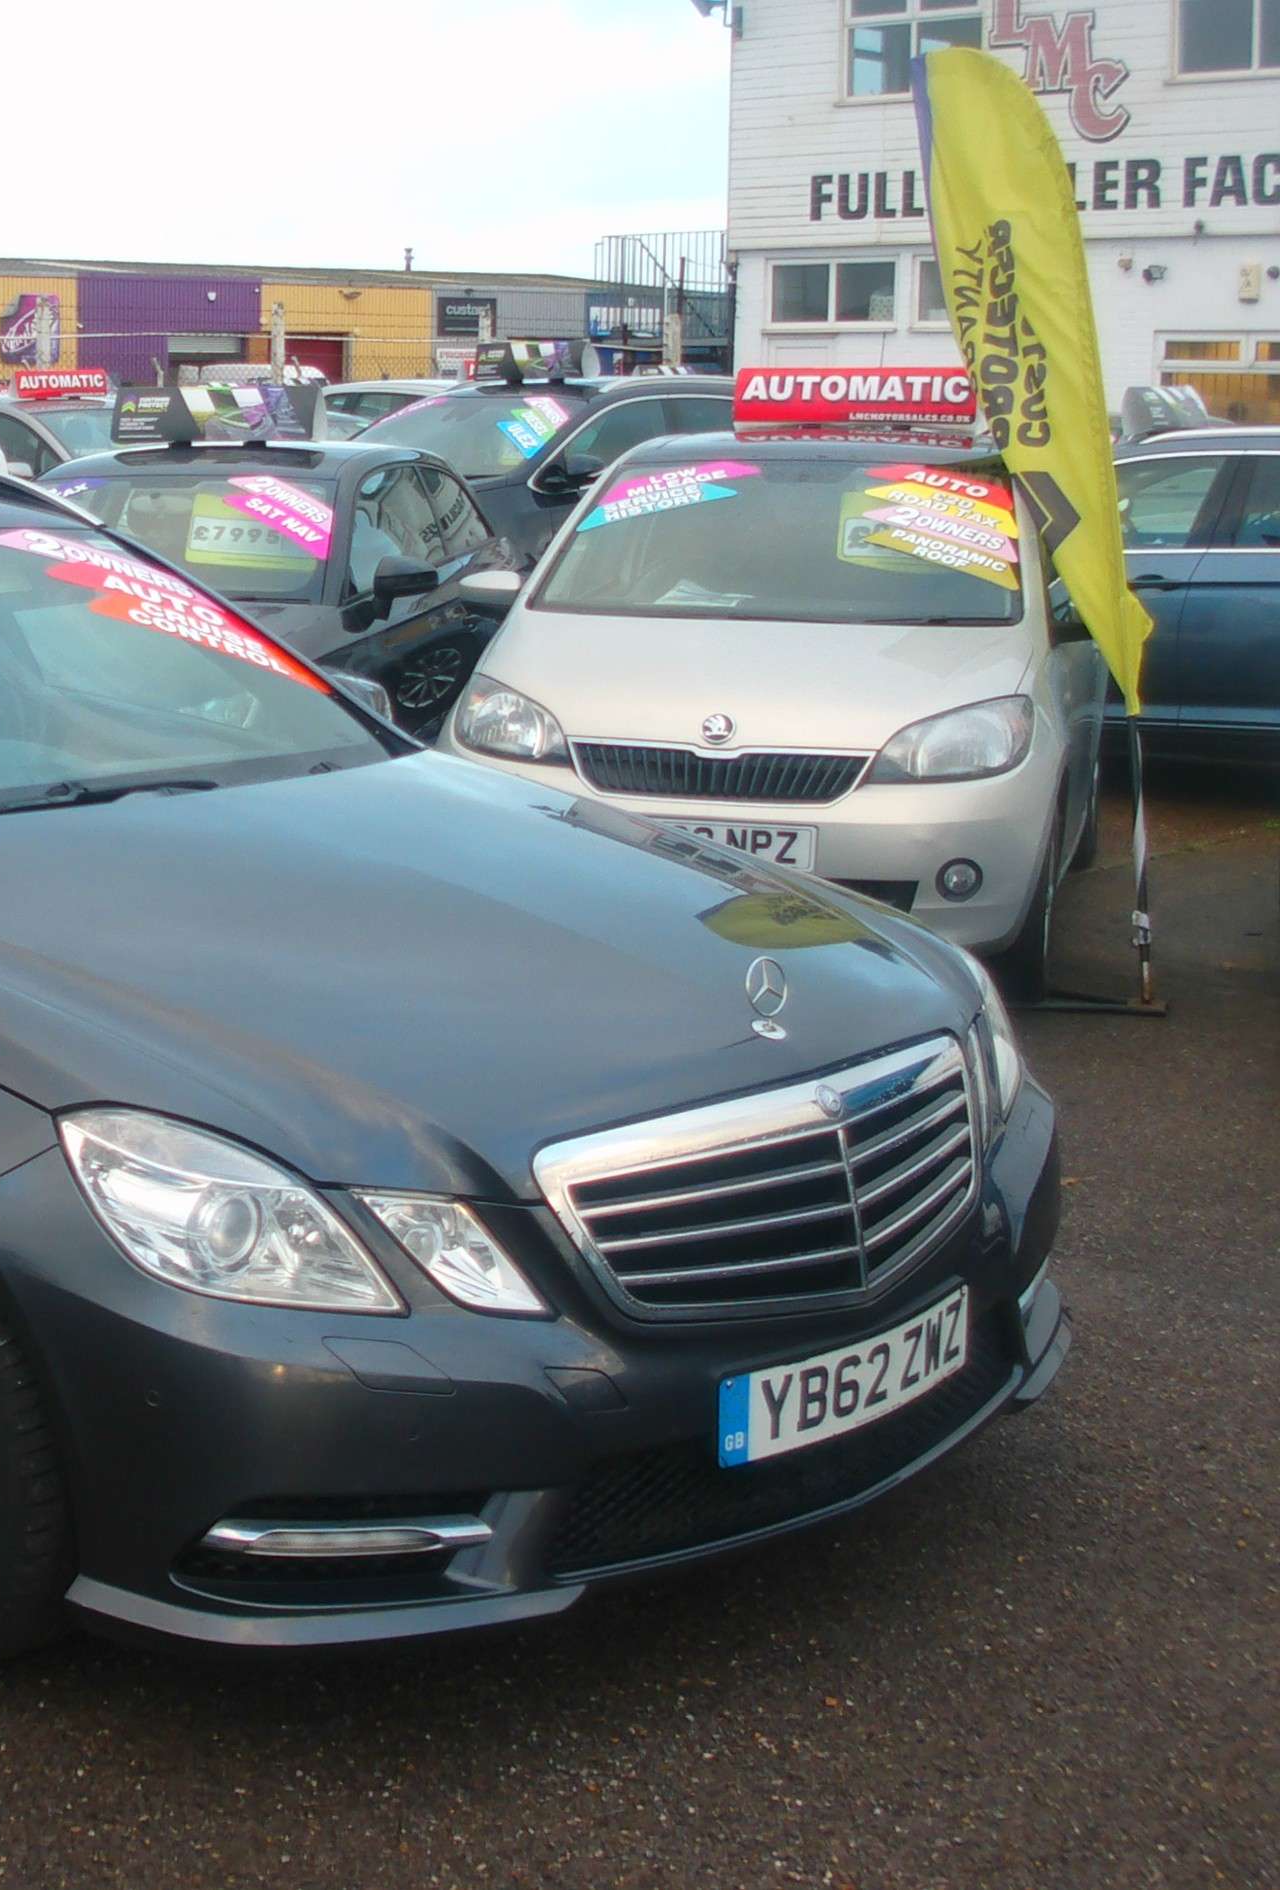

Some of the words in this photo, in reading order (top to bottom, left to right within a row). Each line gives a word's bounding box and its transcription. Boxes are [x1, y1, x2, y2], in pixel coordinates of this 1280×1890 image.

[990, 0, 1131, 143] LMC
[810, 170, 926, 221] FULL
[19, 374, 105, 390] AUTOMATIC
[741, 375, 970, 402] AUTOMATIC
[627, 470, 728, 497] MILEAGE
[648, 467, 697, 484] LOW
[904, 470, 990, 498] AUTO
[604, 485, 701, 511] SERVICE
[605, 493, 703, 522] HISTORY
[887, 491, 950, 513] ROAD
[957, 504, 1000, 528] TAX
[245, 497, 286, 519] SAT
[282, 515, 324, 543] NAV
[890, 528, 1009, 573] PANORAMIC
[912, 544, 972, 569] ROOF
[103, 575, 225, 627] AUTO
[128, 609, 291, 677] CONTROL
[141, 602, 266, 653] CRUISE
[725, 828, 799, 865] NPZ
[761, 1342, 891, 1440] YB62
[900, 1298, 962, 1392] ZWZ
[724, 1431, 745, 1451] GB
